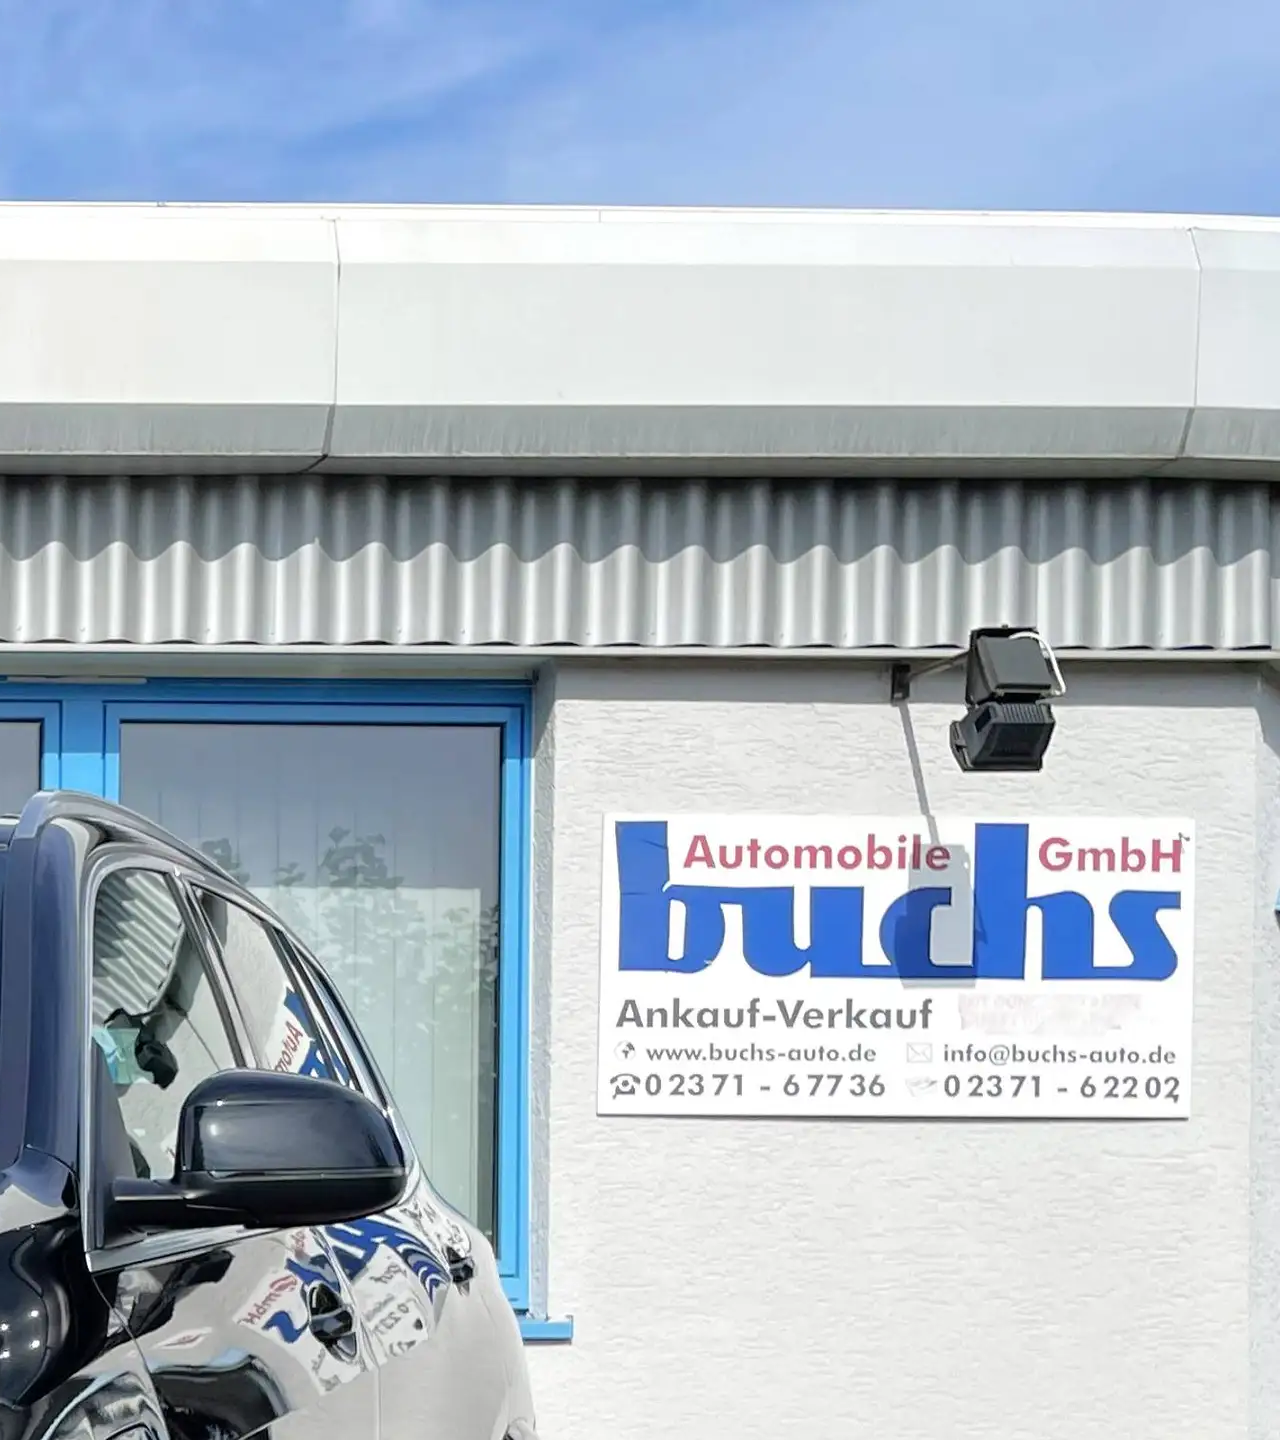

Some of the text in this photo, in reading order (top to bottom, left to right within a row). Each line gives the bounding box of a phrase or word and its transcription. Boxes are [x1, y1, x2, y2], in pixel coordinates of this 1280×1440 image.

[683, 834, 1182, 874] Automobile GmbH
[615, 821, 1181, 981] buchs
[616, 998, 933, 1029] Ankauf-Verkauf
[645, 1042, 877, 1062] www.buchs-auto.de
[943, 1044, 1177, 1066] info@buchs-auto.de
